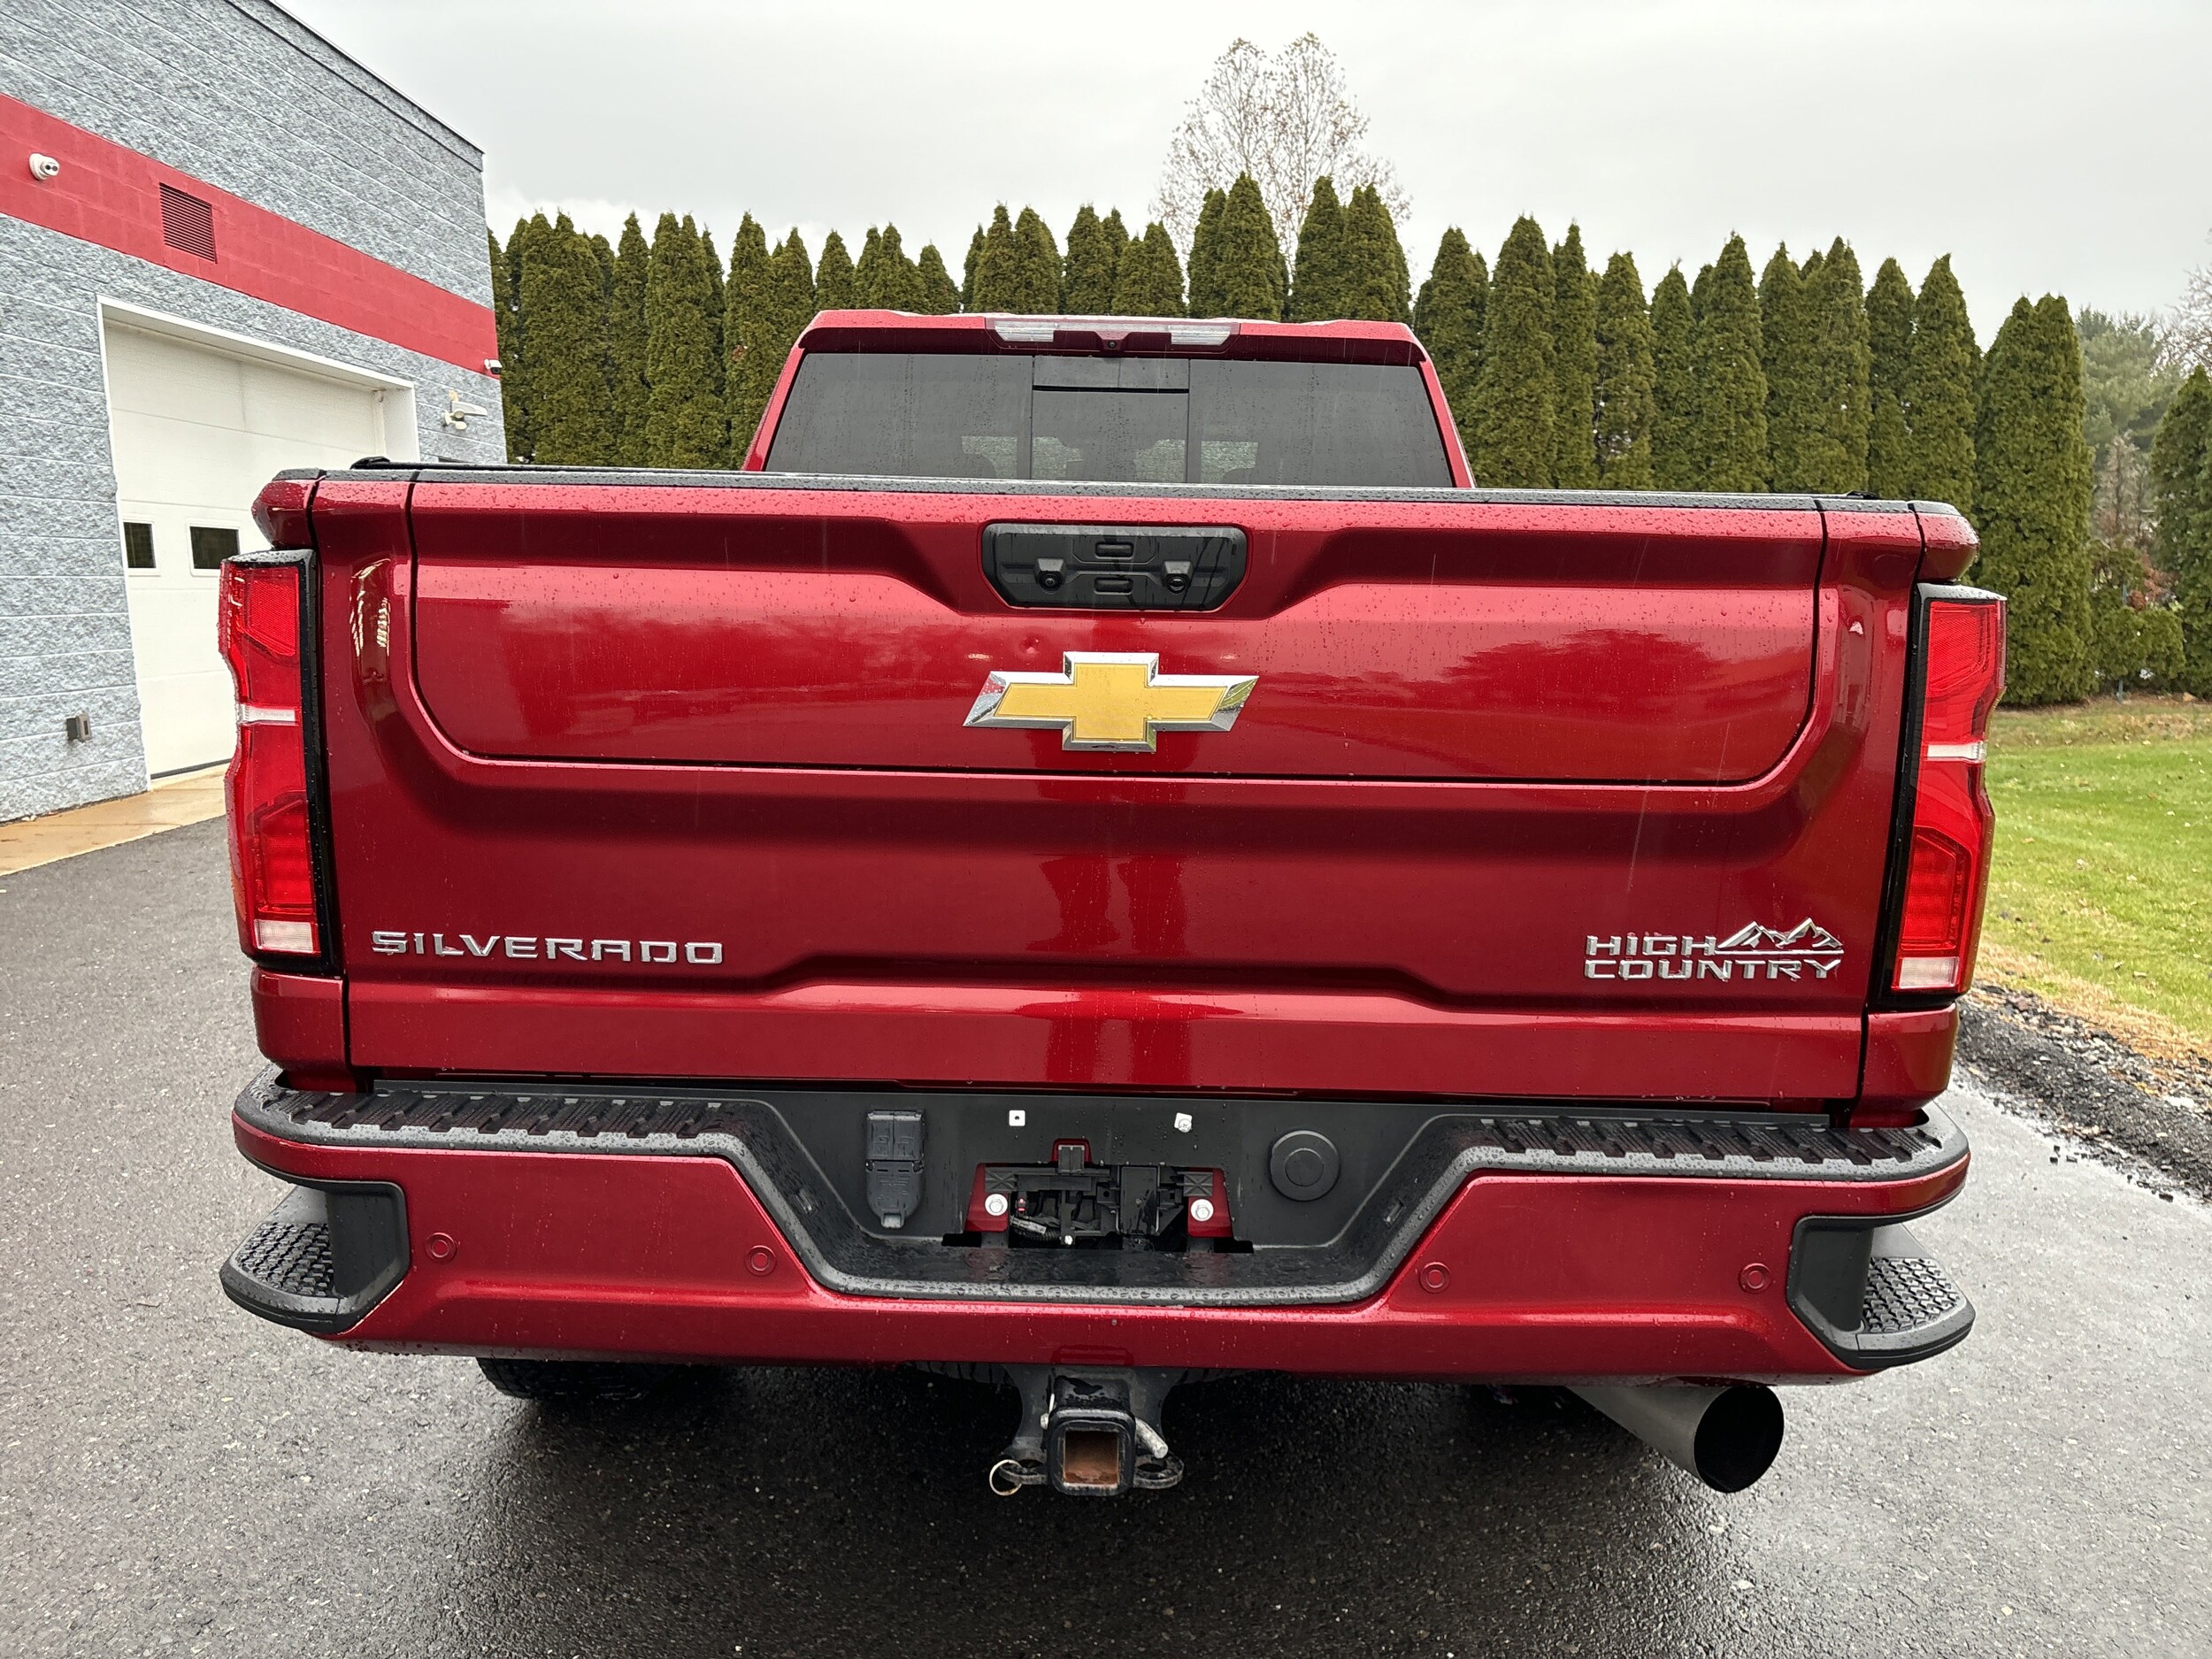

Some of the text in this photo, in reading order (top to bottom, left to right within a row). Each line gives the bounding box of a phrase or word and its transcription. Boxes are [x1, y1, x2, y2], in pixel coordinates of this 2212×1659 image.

[372, 930, 723, 964] SILVERADO
[1586, 935, 1717, 956] HIGH
[1585, 958, 1840, 980] COUNTRY
